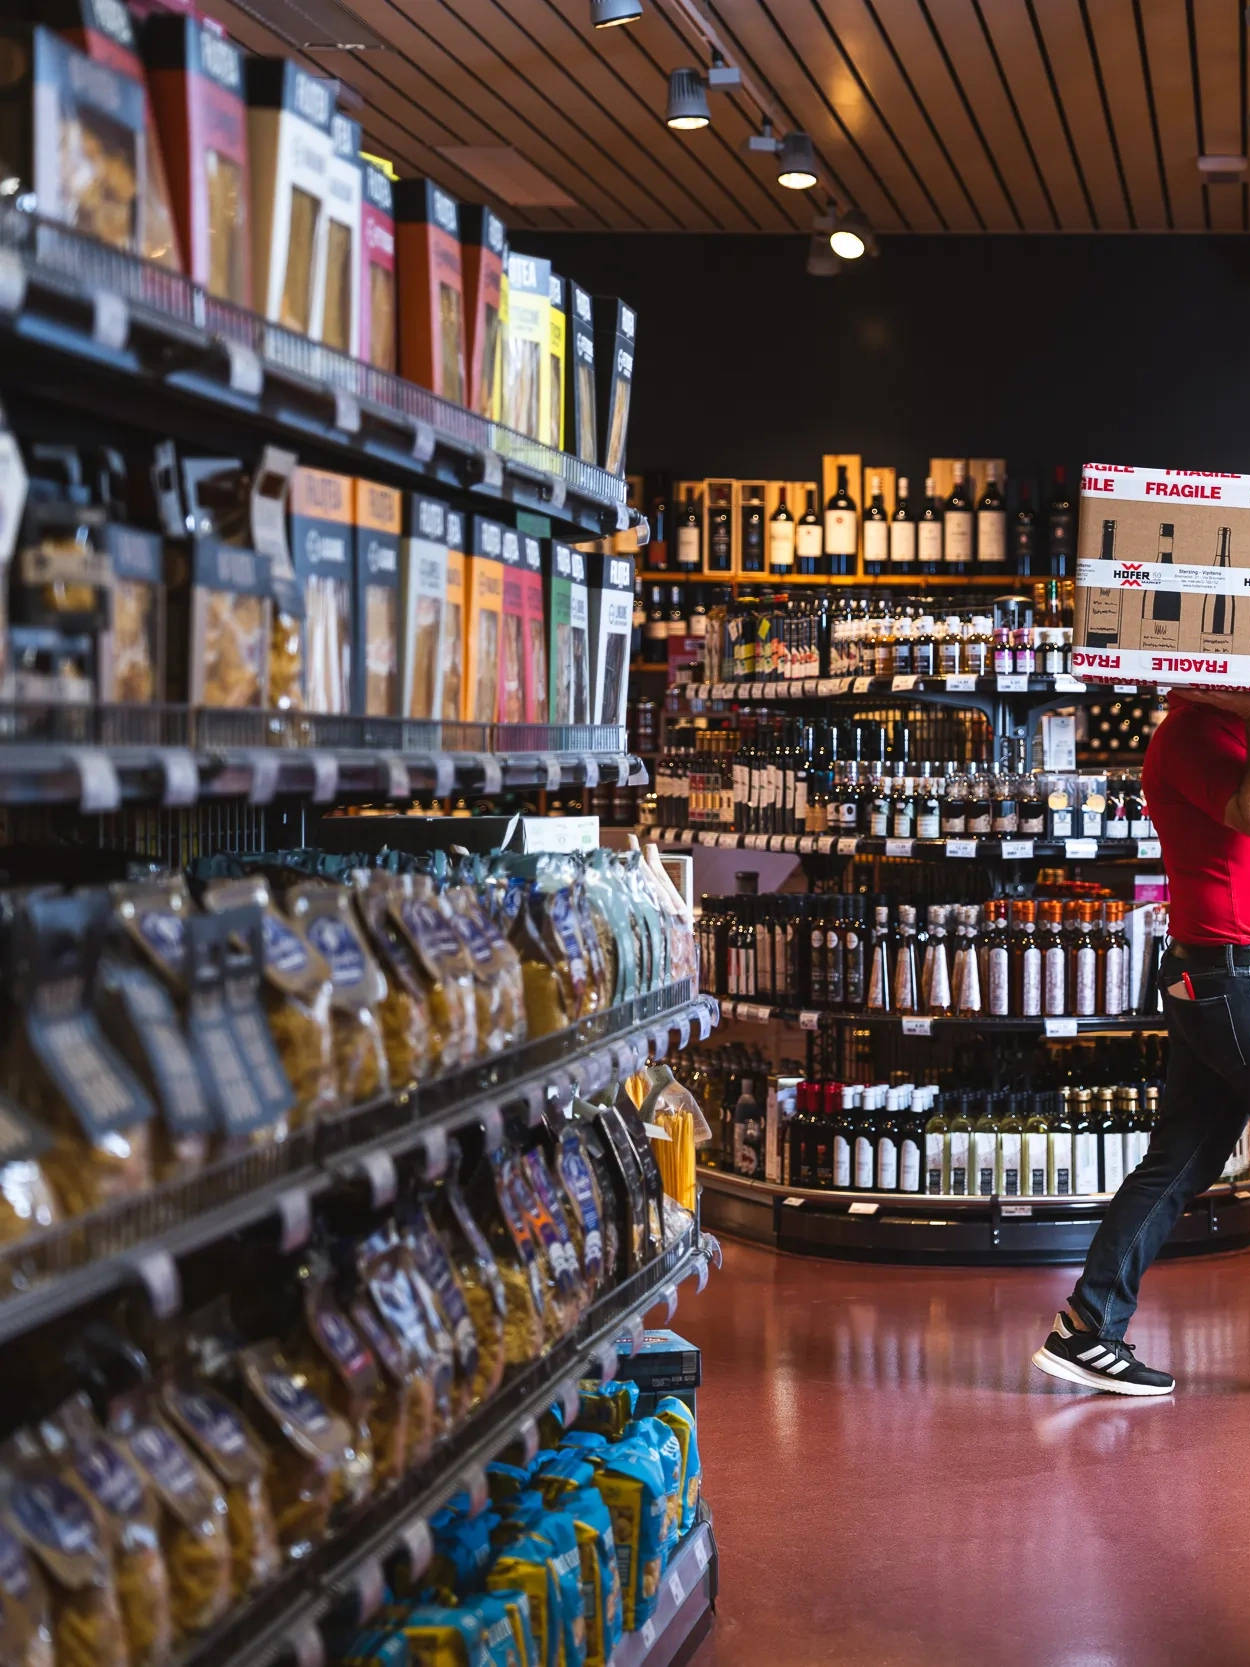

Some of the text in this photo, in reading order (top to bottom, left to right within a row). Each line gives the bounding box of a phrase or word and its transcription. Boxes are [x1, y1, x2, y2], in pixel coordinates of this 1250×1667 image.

[1145, 481, 1222, 499] FRAGILE
[1113, 570, 1151, 581] HOFER
[1072, 652, 1121, 669] FRAG
[1152, 657, 1229, 674] FRAGILE
